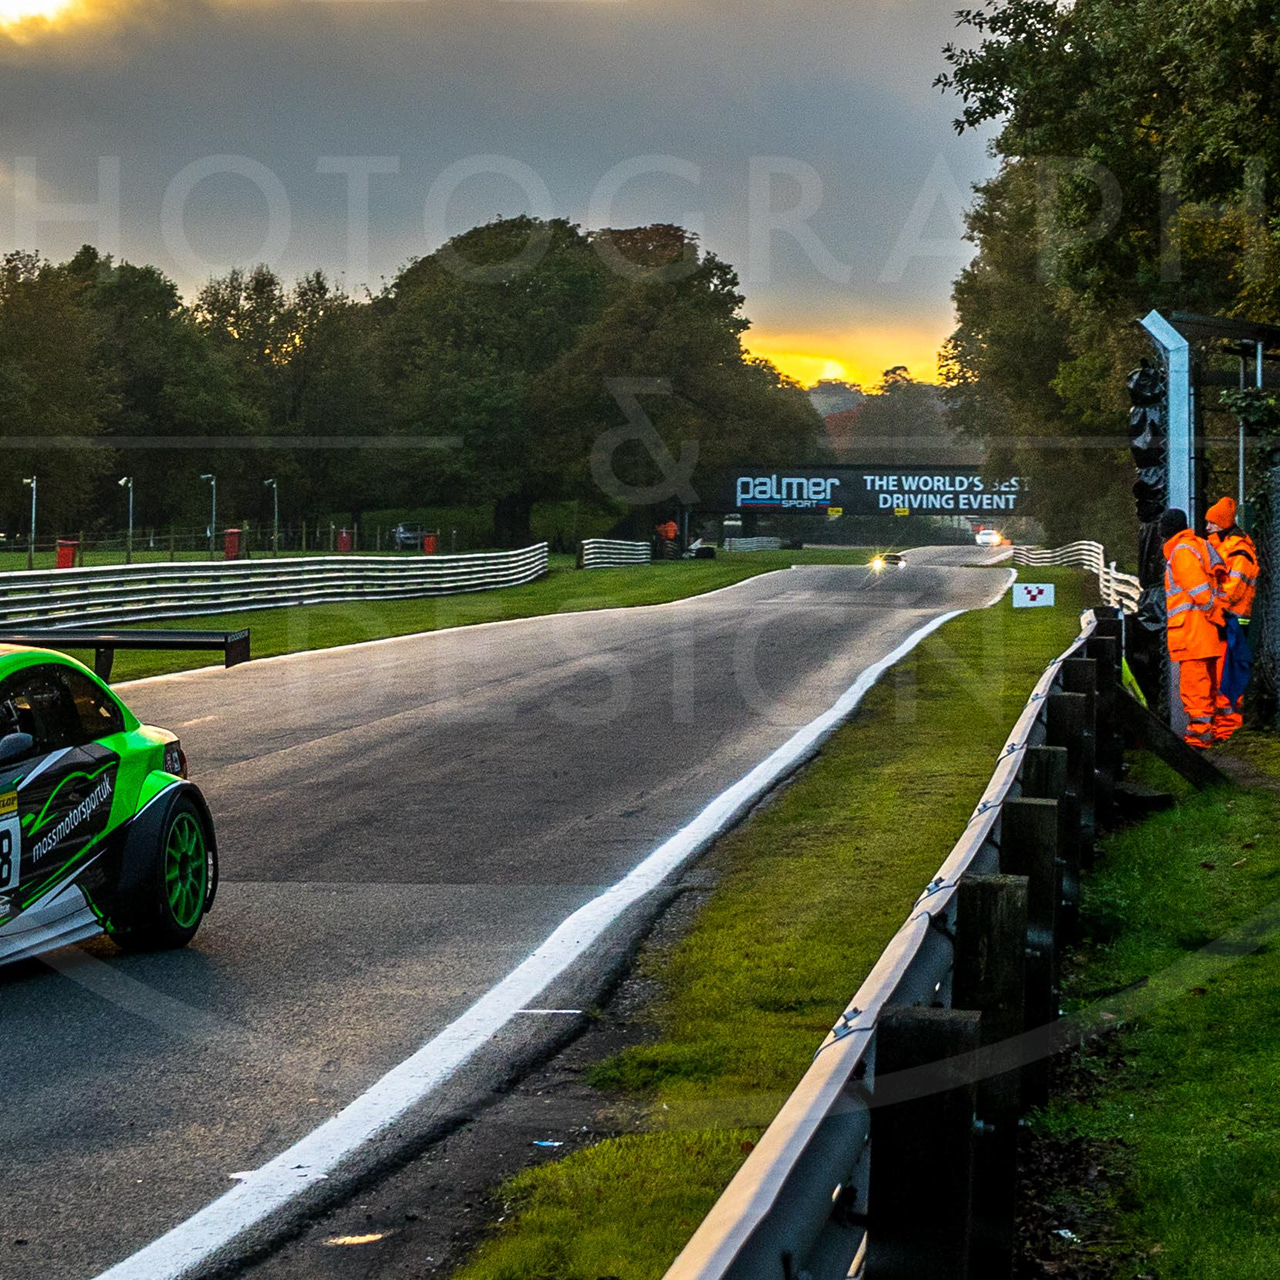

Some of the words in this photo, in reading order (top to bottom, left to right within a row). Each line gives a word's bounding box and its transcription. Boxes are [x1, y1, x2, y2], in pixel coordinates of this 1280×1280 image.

[736, 474, 840, 507] palmer
[863, 476, 898, 491] THE
[901, 475, 984, 491] WORLD'S
[781, 500, 818, 508] SPORT
[879, 494, 955, 510] DRIVING
[959, 494, 1017, 510] EVENT
[32, 773, 113, 863] mossmotorsportuk
